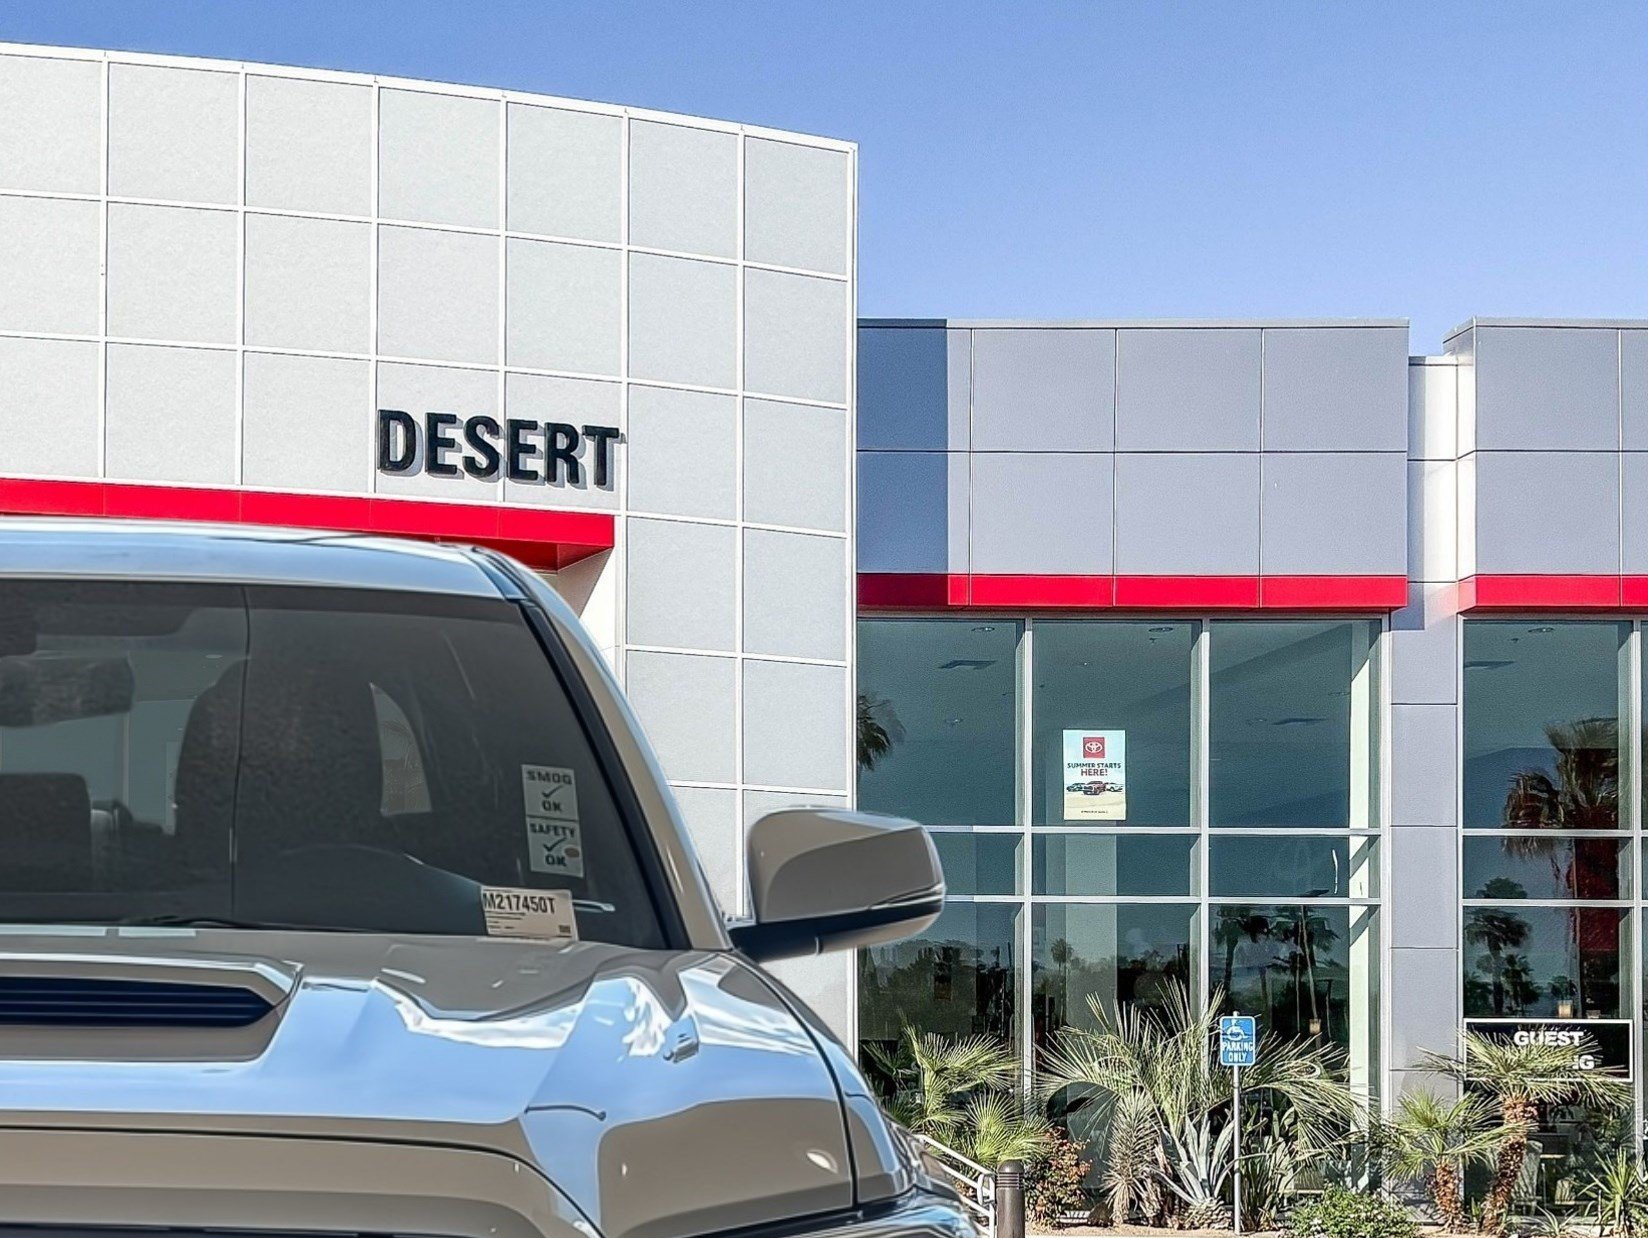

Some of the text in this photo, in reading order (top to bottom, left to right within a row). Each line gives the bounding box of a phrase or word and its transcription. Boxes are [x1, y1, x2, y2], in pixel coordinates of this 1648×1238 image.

[377, 409, 620, 488] DESERT
[526, 770, 572, 785] SMOG
[1080, 769, 1108, 777] HERE!
[542, 801, 562, 812] OK
[529, 823, 576, 837] SAFETY
[545, 854, 566, 867] OK
[1513, 1031, 1584, 1046] GUEST
[1222, 1042, 1254, 1052] PARKING
[1228, 1052, 1248, 1062] ONLY
